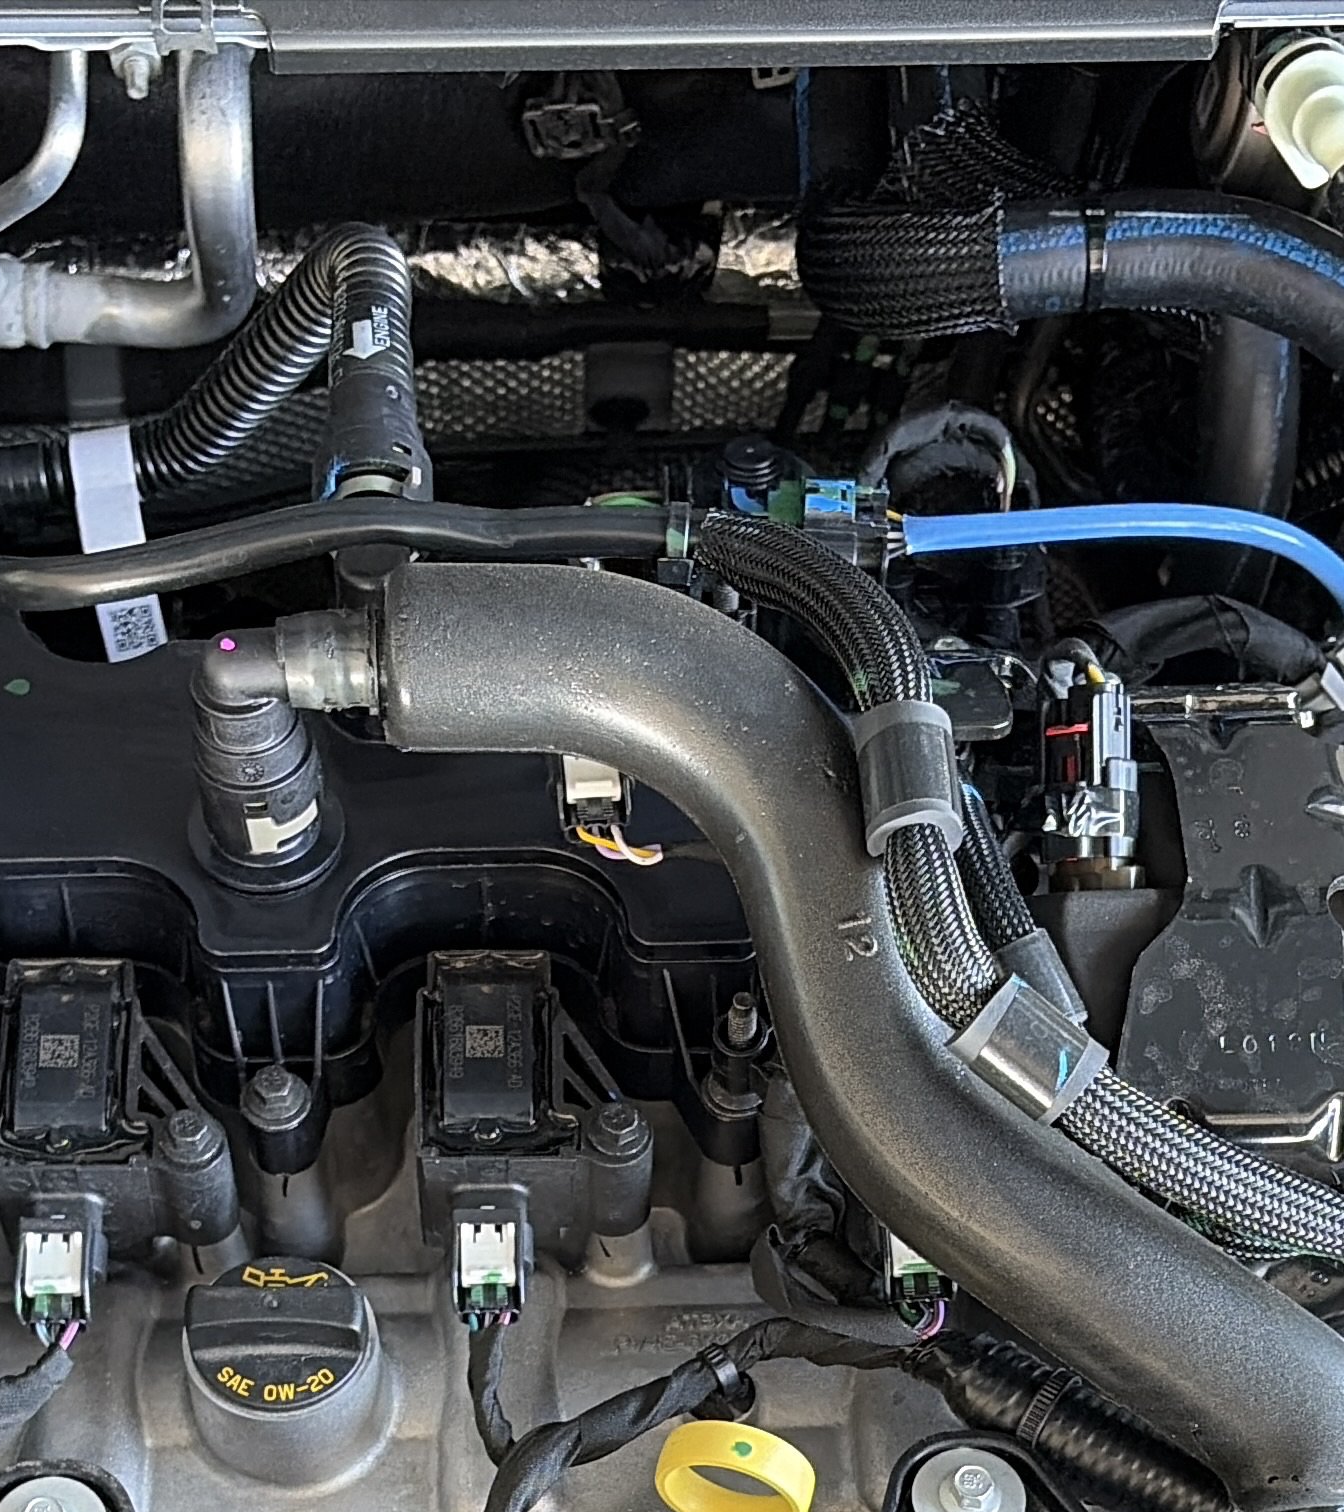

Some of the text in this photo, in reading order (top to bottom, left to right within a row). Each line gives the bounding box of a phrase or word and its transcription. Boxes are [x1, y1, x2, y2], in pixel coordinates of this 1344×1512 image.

[371, 305, 391, 348] ENGINE
[217, 1366, 334, 1401] SAE 0W-20
